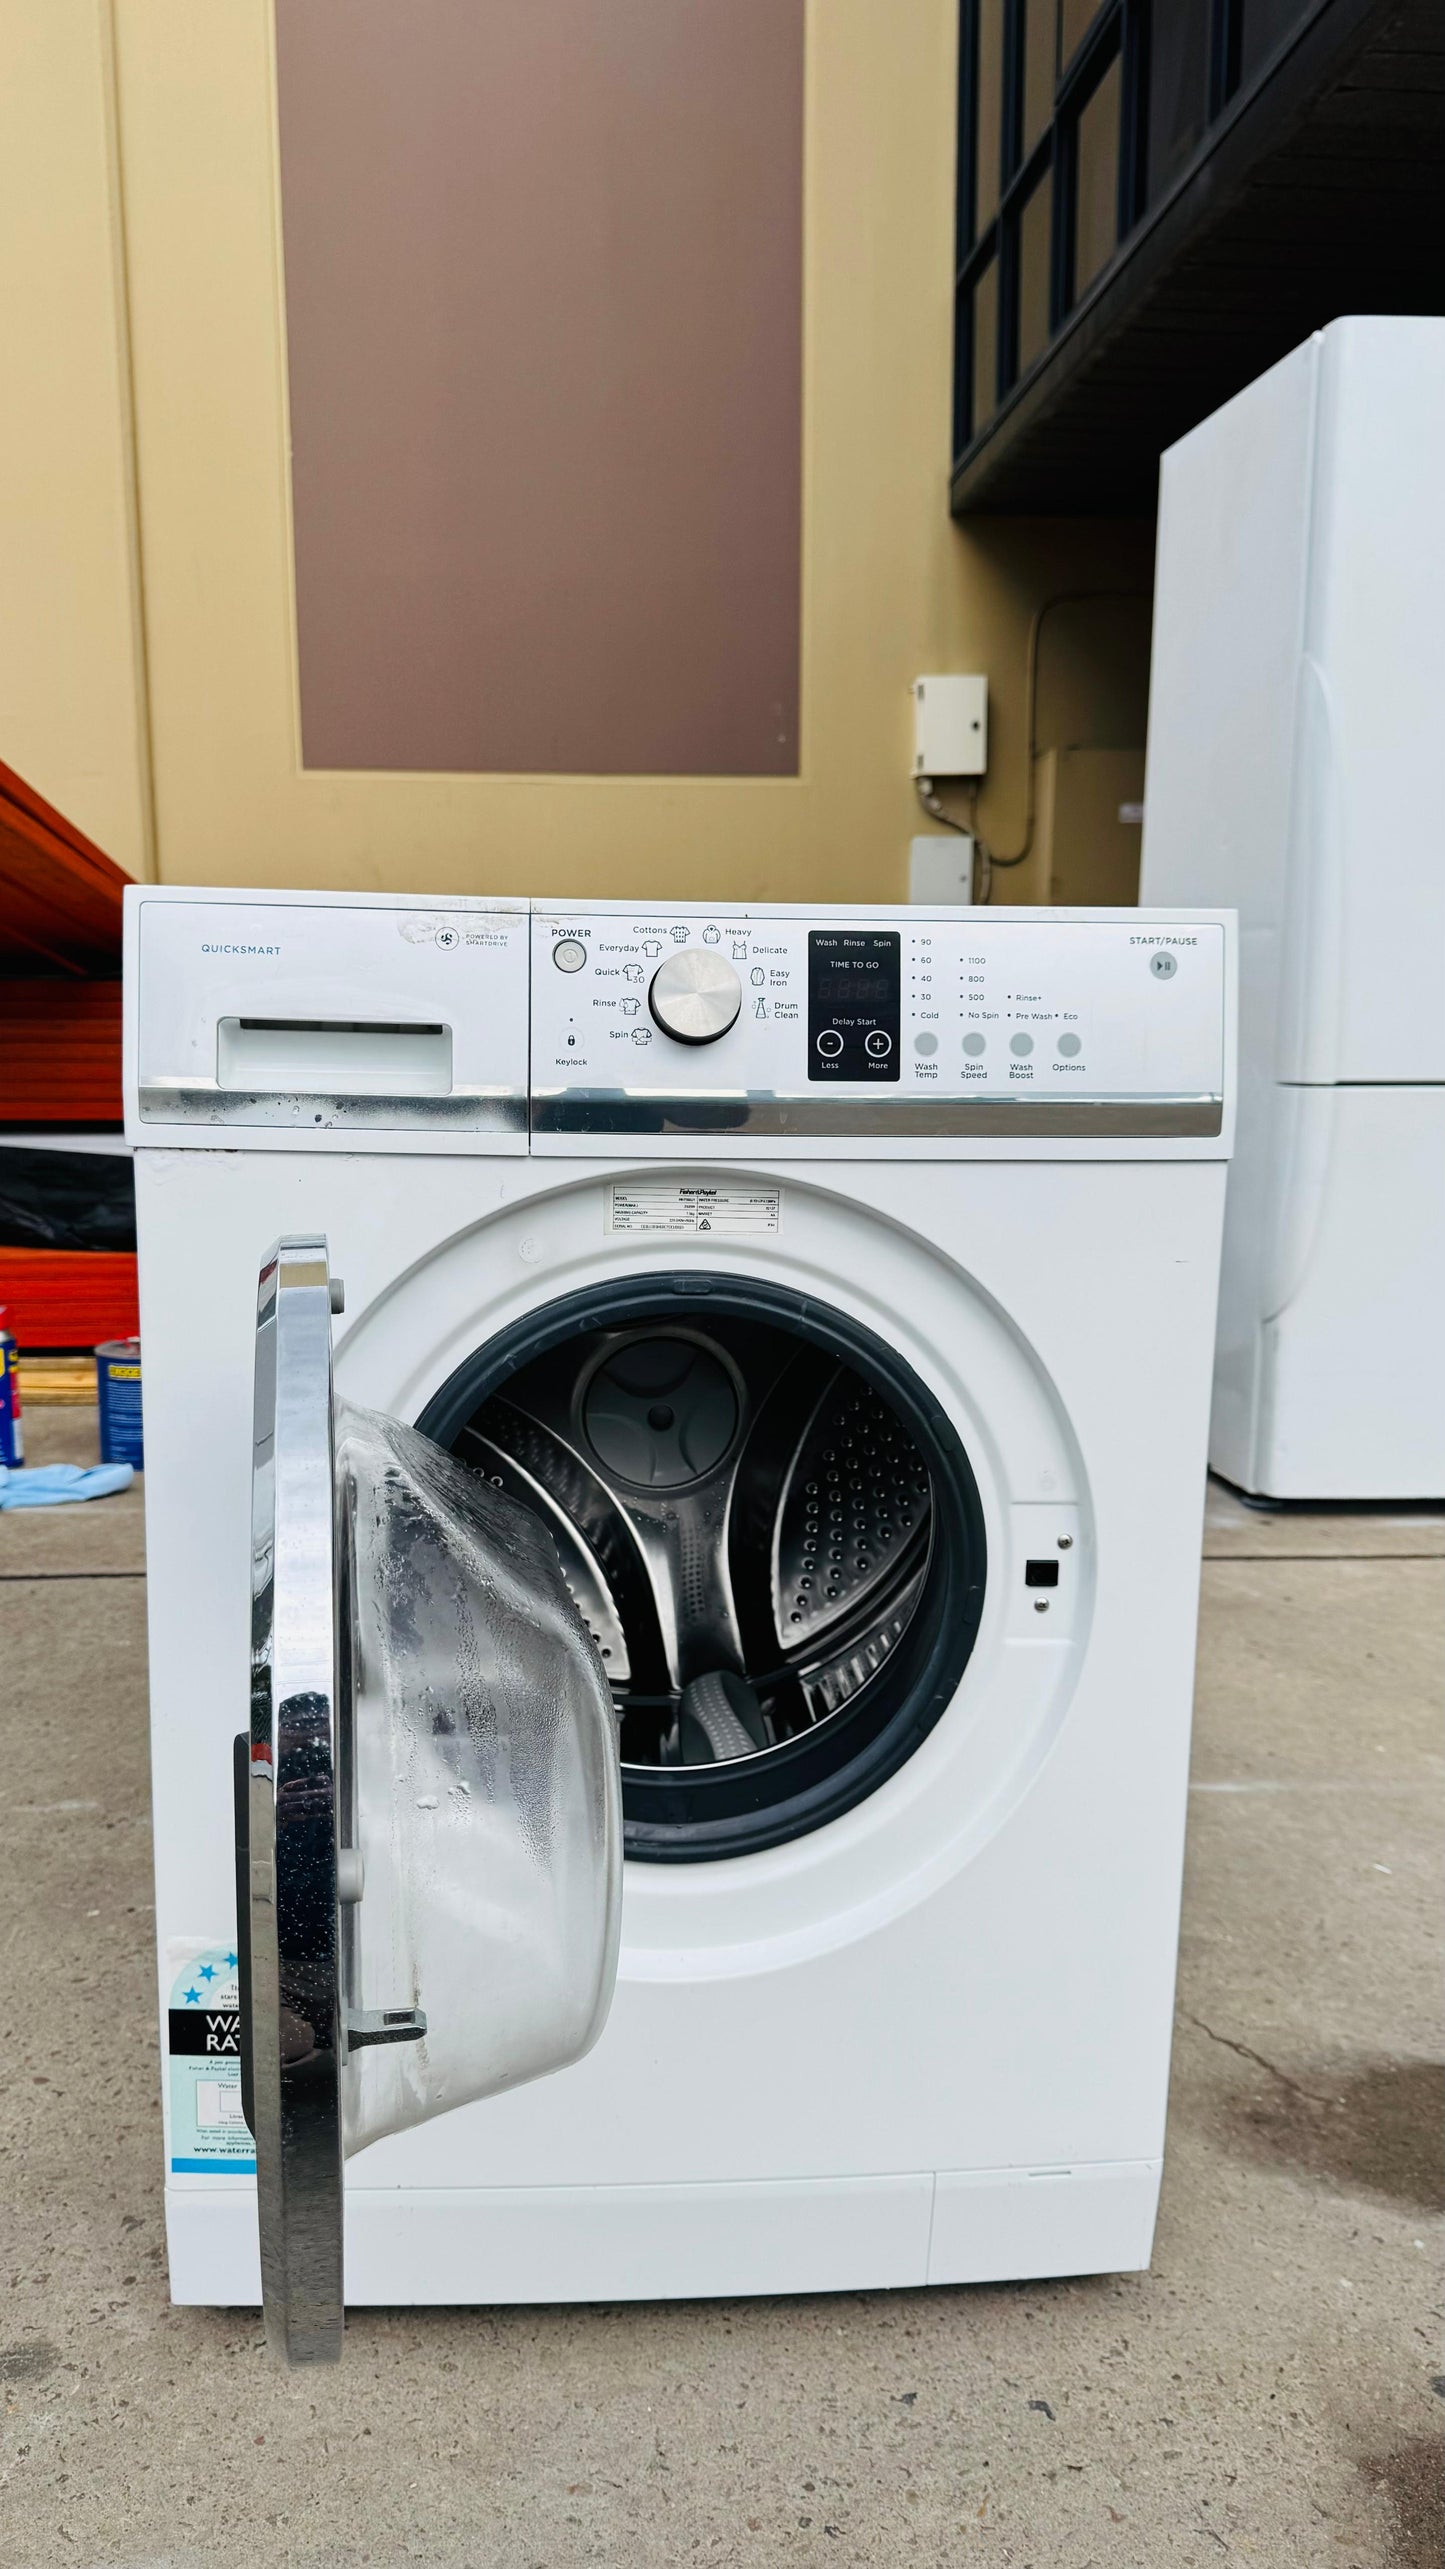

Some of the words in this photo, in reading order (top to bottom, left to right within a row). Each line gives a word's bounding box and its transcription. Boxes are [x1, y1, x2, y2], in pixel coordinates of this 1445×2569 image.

[551, 929, 592, 938] POWER
[633, 926, 667, 934] Cottons
[725, 928, 752, 937] Heavy
[815, 939, 838, 947] Wash
[843, 939, 866, 947] Rinse
[873, 939, 891, 948] Spin
[1129, 936, 1198, 946] START/PAUSE
[201, 944, 281, 956] QUICKSMART
[599, 943, 640, 953] Everyday
[752, 946, 788, 954] Delicate
[852, 961, 864, 969] TO
[866, 961, 880, 969] GO
[594, 968, 620, 976] Quick
[770, 970, 791, 979] Easy
[770, 979, 787, 987] Iron
[592, 999, 617, 1007] Rinse
[774, 1002, 798, 1010] Drum
[774, 1011, 799, 1019] Clean
[981, 1012, 1000, 1020] Spin
[832, 1018, 855, 1026] Delay
[857, 1018, 876, 1026] Start
[609, 1031, 629, 1039] Spin
[555, 1058, 588, 1067] Keylock
[914, 1063, 938, 1071] Wash
[964, 1063, 984, 1072] Spin
[1009, 1063, 1033, 1071] Wash
[1052, 1063, 1086, 1072] Options
[914, 1071, 938, 1079] Temp
[960, 1071, 988, 1079] Speed
